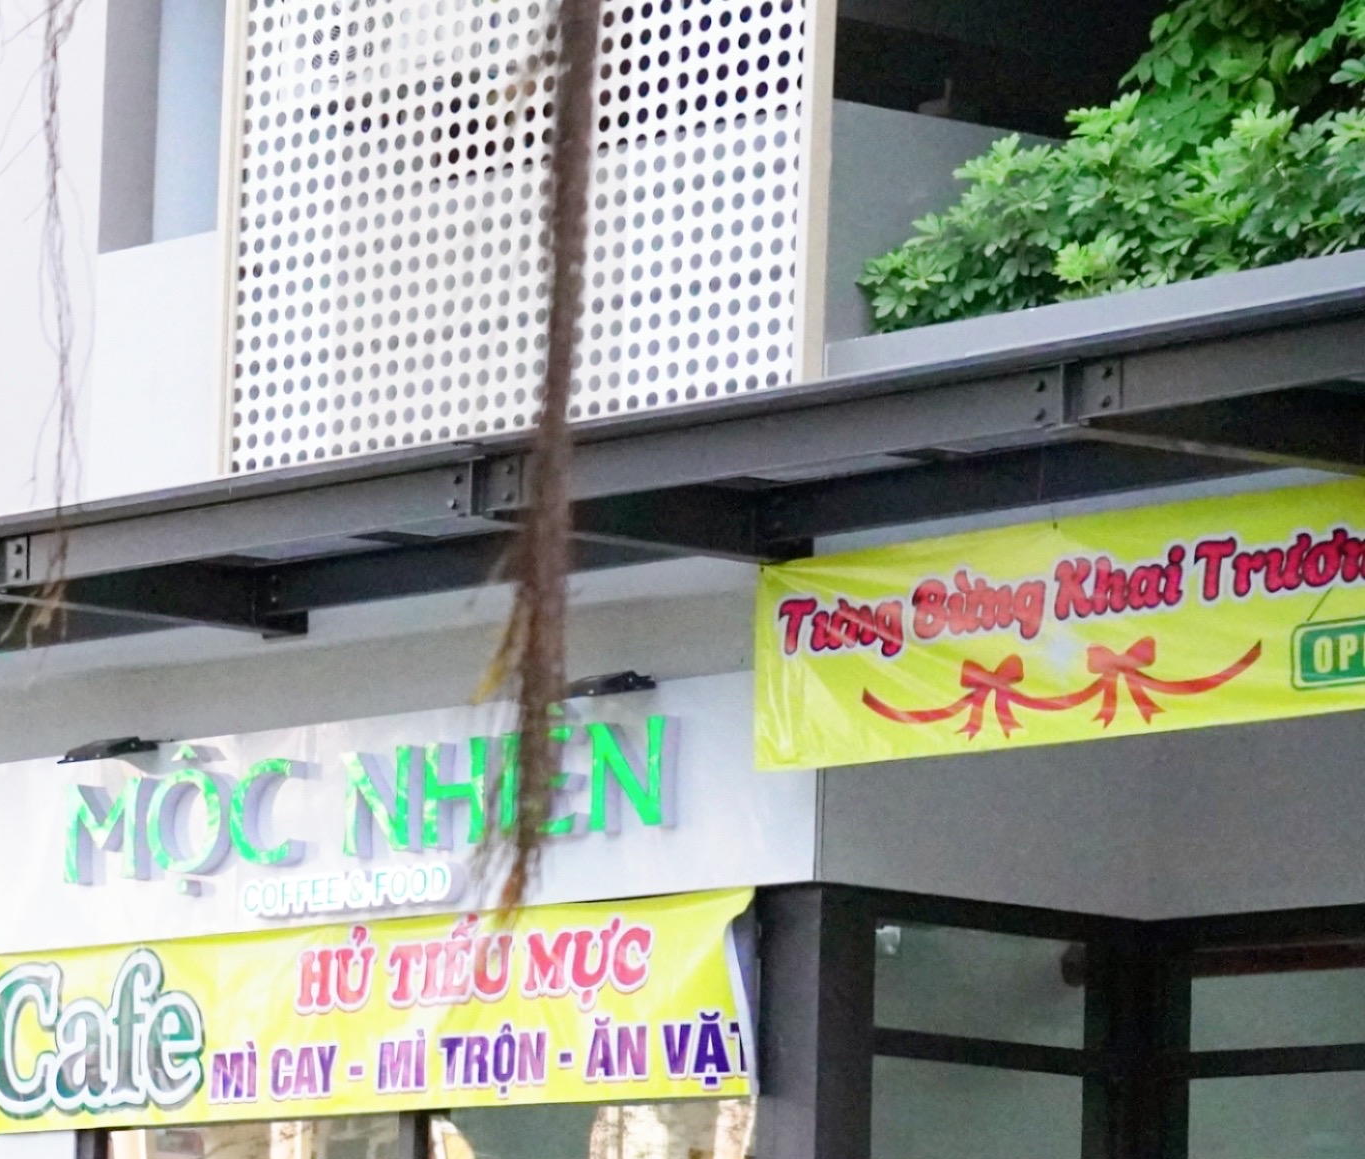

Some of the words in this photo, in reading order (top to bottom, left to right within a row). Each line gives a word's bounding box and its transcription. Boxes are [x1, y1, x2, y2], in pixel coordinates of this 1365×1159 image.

[1053, 545, 1185, 618] Khai
[1313, 633, 1365, 674] OP
[63, 742, 300, 897] MỘC
[241, 875, 341, 917] COFFEE
[346, 870, 366, 905] &
[372, 864, 451, 904] FOOD
[297, 925, 375, 1007] HỦ
[390, 913, 513, 1002] TIẾU
[524, 917, 651, 1005] MỰC
[210, 1040, 257, 1099] MÌ
[270, 1045, 338, 1097] CAY
[377, 1028, 426, 1090] MÌ
[439, 1023, 547, 1094] TRỘN
[585, 1016, 648, 1078] ĂN
